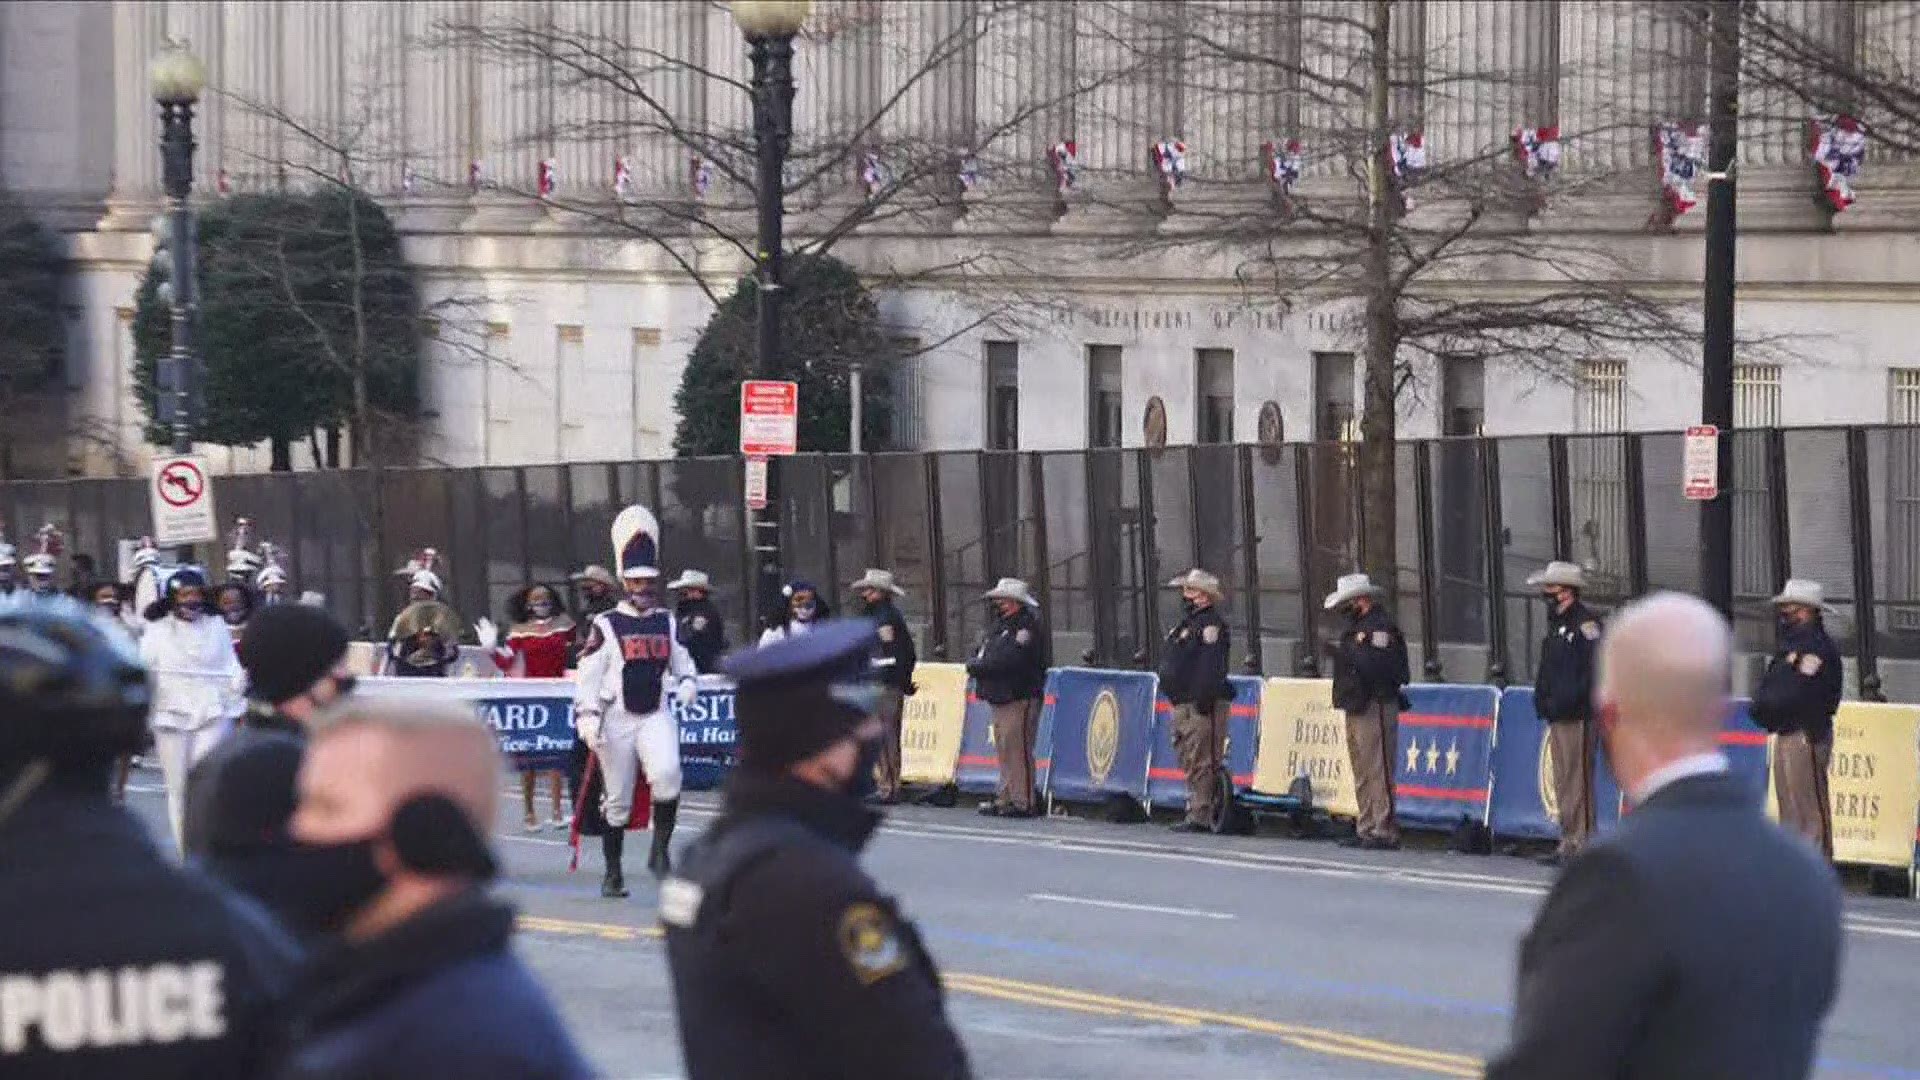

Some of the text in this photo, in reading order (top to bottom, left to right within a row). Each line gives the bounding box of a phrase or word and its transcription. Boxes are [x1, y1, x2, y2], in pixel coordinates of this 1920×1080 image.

[703, 727, 737, 743] Har
[1295, 719, 1339, 745] BIDEN
[1833, 792, 1881, 820] RRIS
[2, 962, 227, 1053] POLICE
